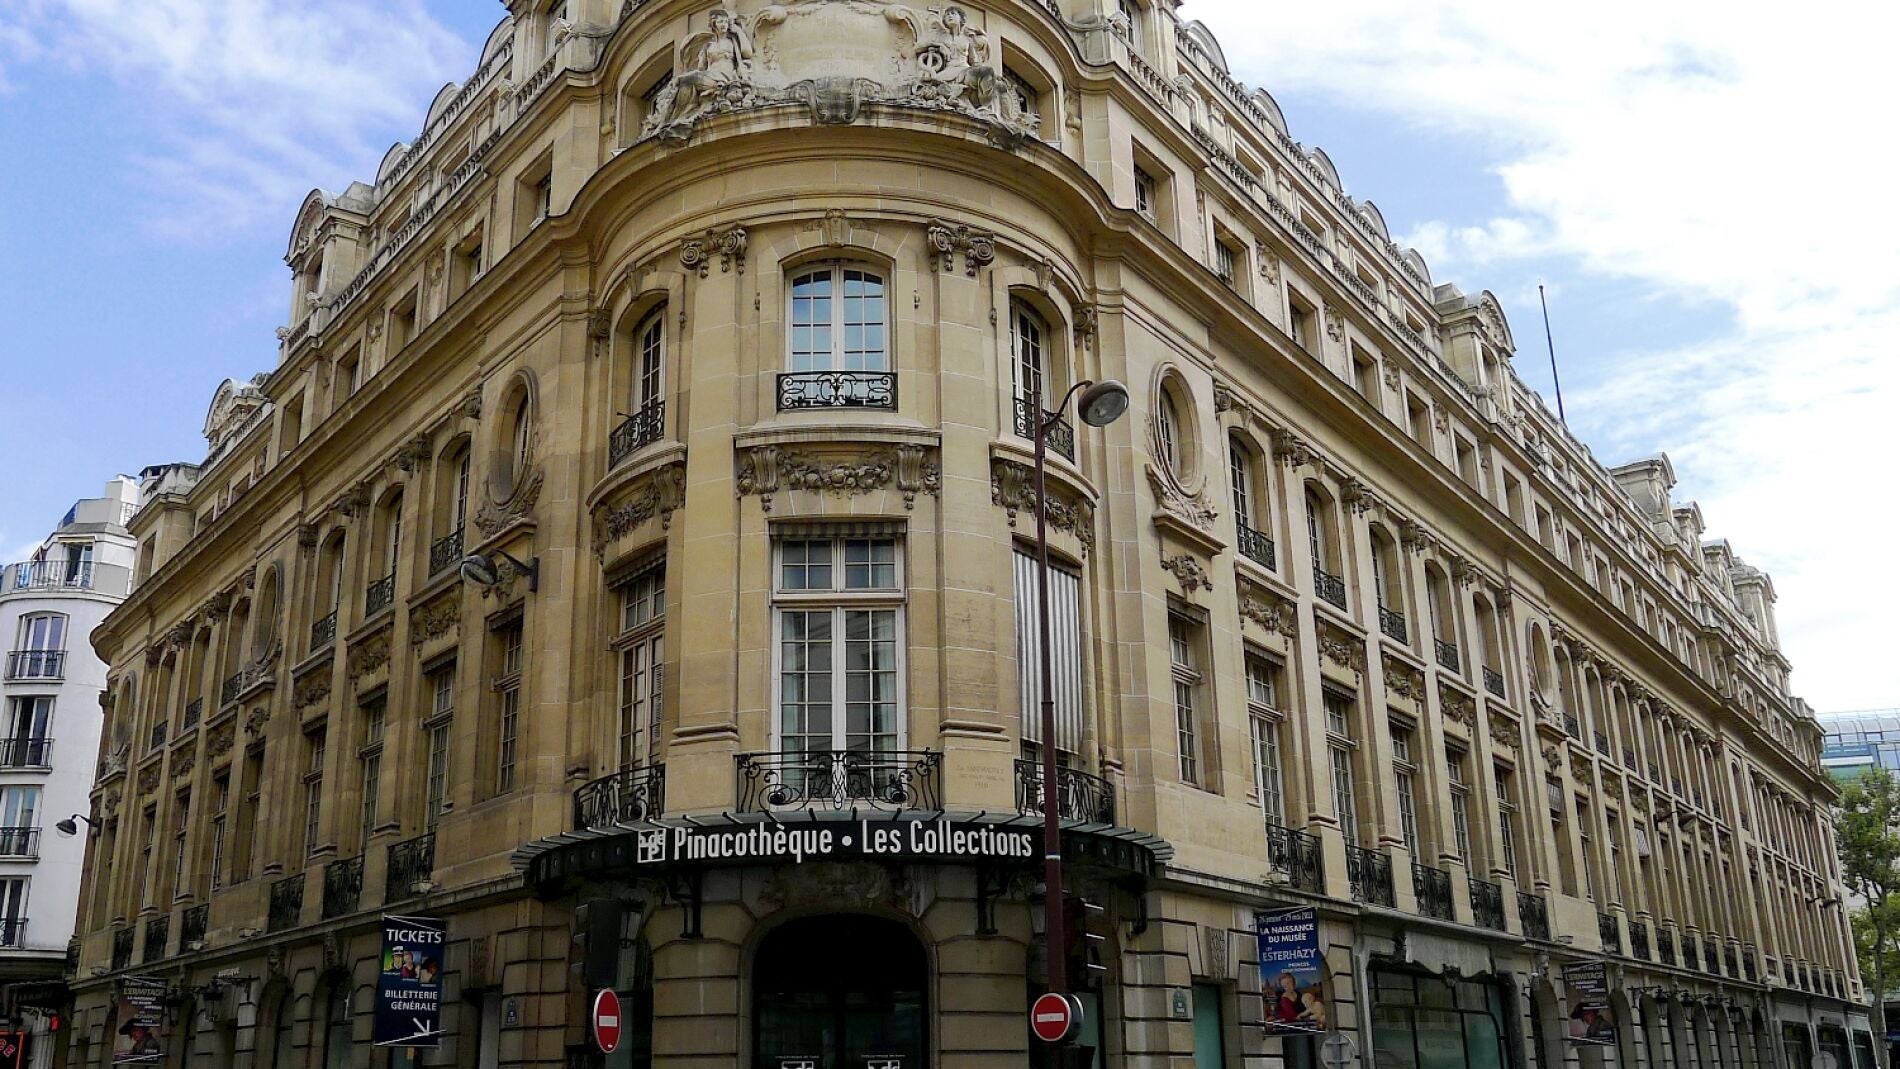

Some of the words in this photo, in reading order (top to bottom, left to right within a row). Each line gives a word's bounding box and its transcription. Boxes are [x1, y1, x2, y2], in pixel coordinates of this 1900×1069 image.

[674, 822, 833, 864] Pinacothèque
[862, 819, 901, 853] Les
[910, 820, 1032, 857] Collections
[1259, 928, 1270, 936] LA
[1271, 923, 1314, 934] NAISSANCE
[385, 929, 442, 944] TICKETS
[1268, 935, 1280, 943] DU
[1281, 932, 1307, 942] MUSÉE
[384, 989, 438, 1000] BILLETTERIE
[390, 1000, 438, 1012] GÉNÉRALE
